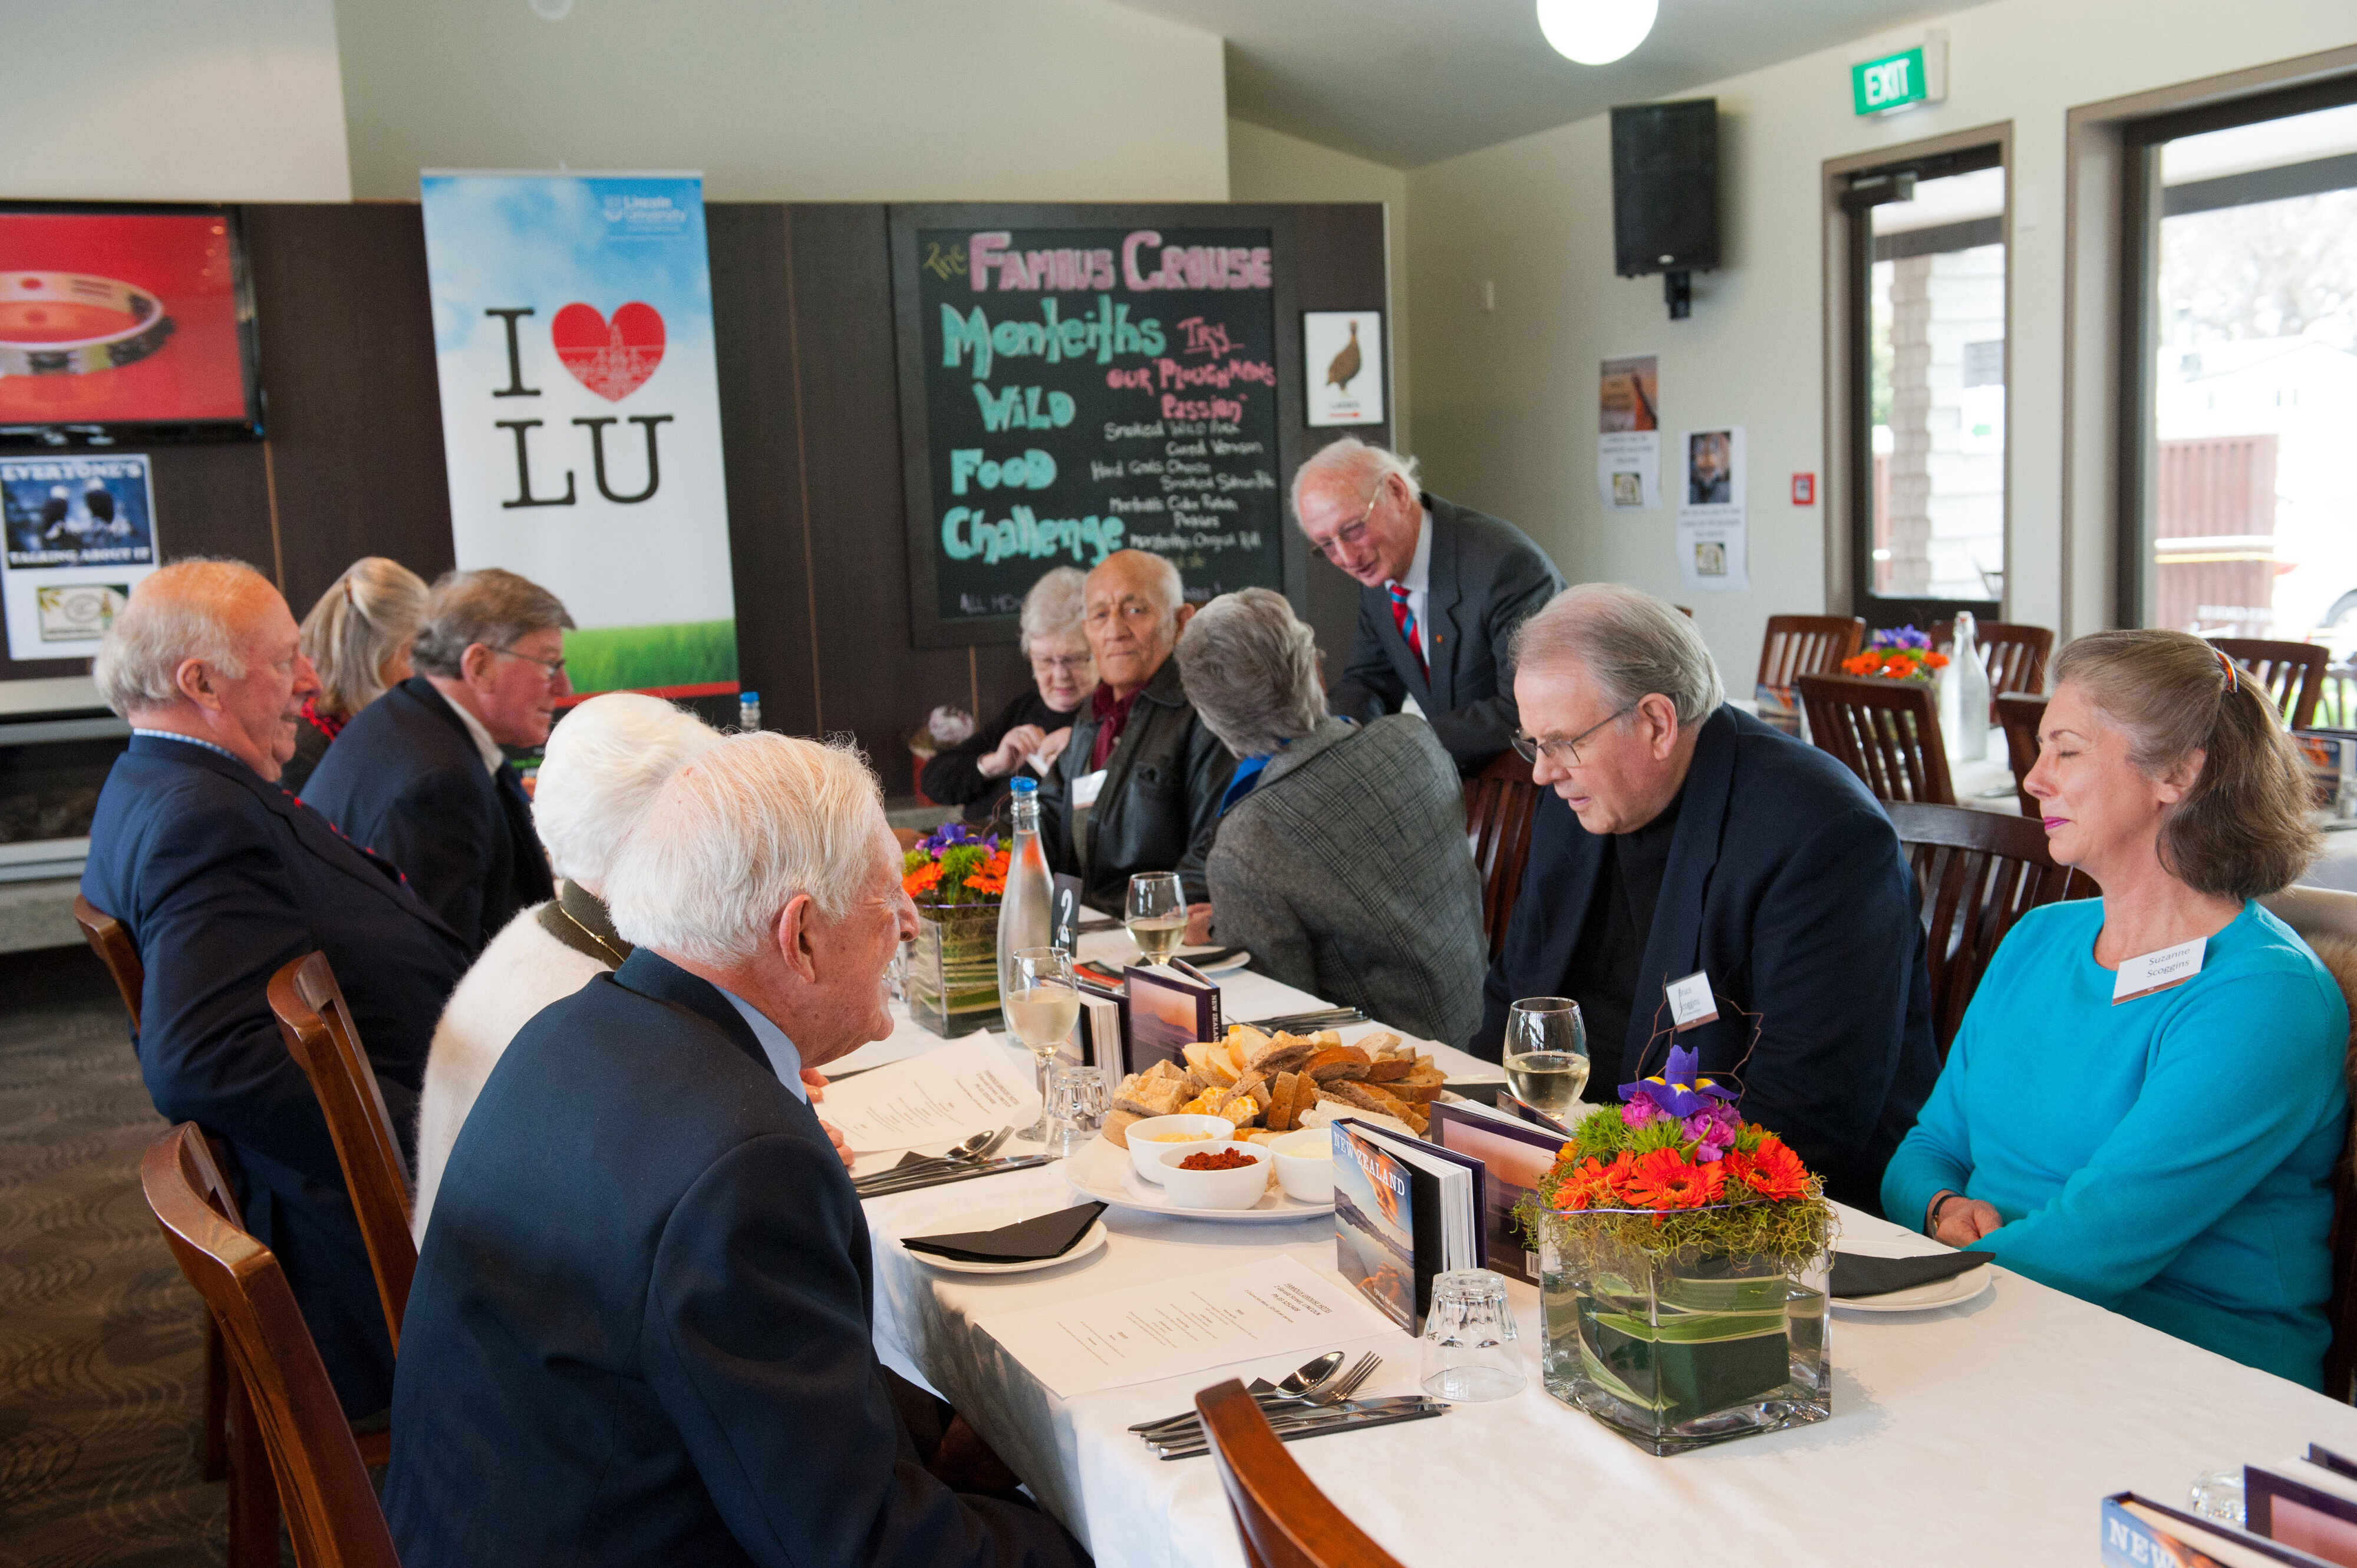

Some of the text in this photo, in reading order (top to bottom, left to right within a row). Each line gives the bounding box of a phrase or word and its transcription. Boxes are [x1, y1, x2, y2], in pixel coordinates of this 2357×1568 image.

[1864, 58, 1910, 106] EXIT
[485, 308, 541, 397] I
[941, 294, 1166, 379] Monteiths
[493, 414, 674, 509] LU
[941, 504, 1125, 567] Challenge
[1060, 889, 1073, 943] 2
[2147, 959, 2190, 979] Scoggins
[2148, 948, 2191, 966] Suzanne
[1334, 1131, 1405, 1196] NEW ZEALAND
[2109, 1517, 2176, 1568] NEW
